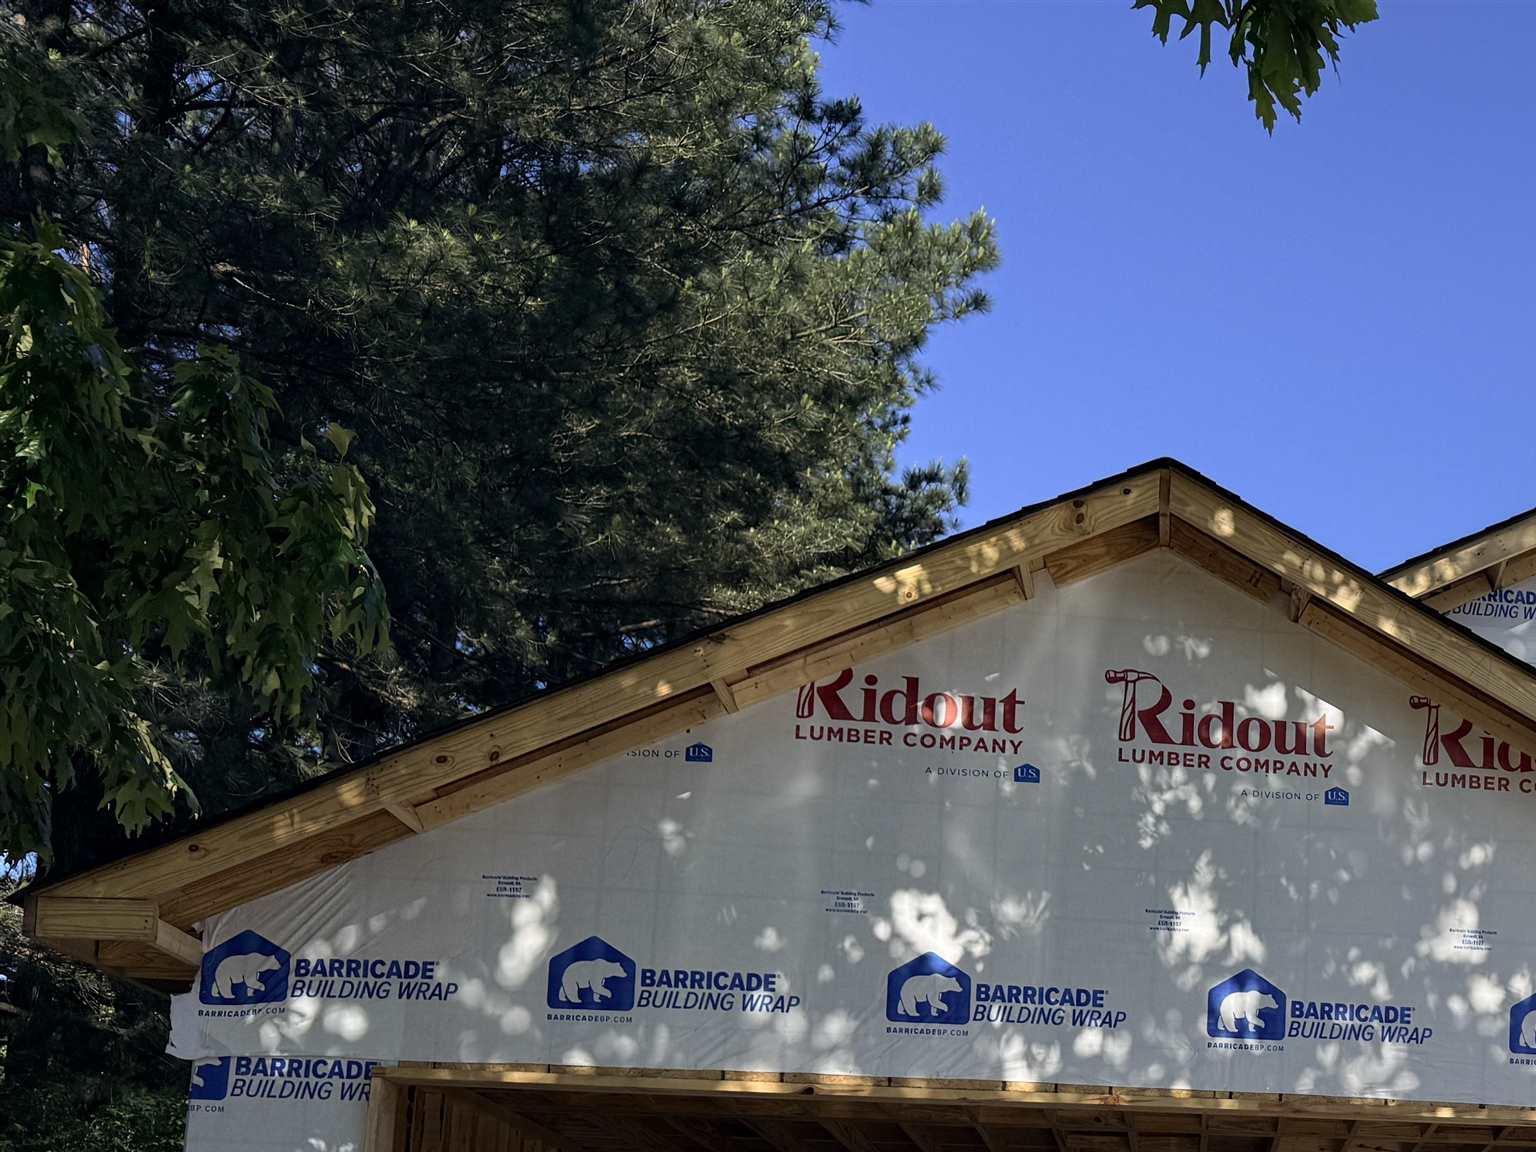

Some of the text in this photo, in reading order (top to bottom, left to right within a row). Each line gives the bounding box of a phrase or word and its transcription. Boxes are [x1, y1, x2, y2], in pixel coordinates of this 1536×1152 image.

[796, 667, 1025, 734] Ridout
[1106, 669, 1335, 757] Ridout
[794, 725, 1023, 754] LUMBER COMPANY
[938, 766, 989, 778] DIVISION
[1118, 748, 1333, 778] LUMBER COMPANY
[1422, 772, 1510, 792] LUMBER
[1252, 790, 1300, 801] DIVISION
[294, 959, 435, 980] BARRICADE
[640, 968, 776, 992] BARRICADE
[291, 980, 458, 1001] BUILDING WRAP
[637, 989, 800, 1014] BUILDING WRAP
[976, 984, 1105, 1008] BARRICADE
[972, 1004, 1126, 1029] BUILDING WRAP
[1290, 1000, 1412, 1024] BARRICADE
[1288, 1021, 1432, 1045] BUILDING WRAP
[230, 1080, 372, 1101] BUILDING WR
